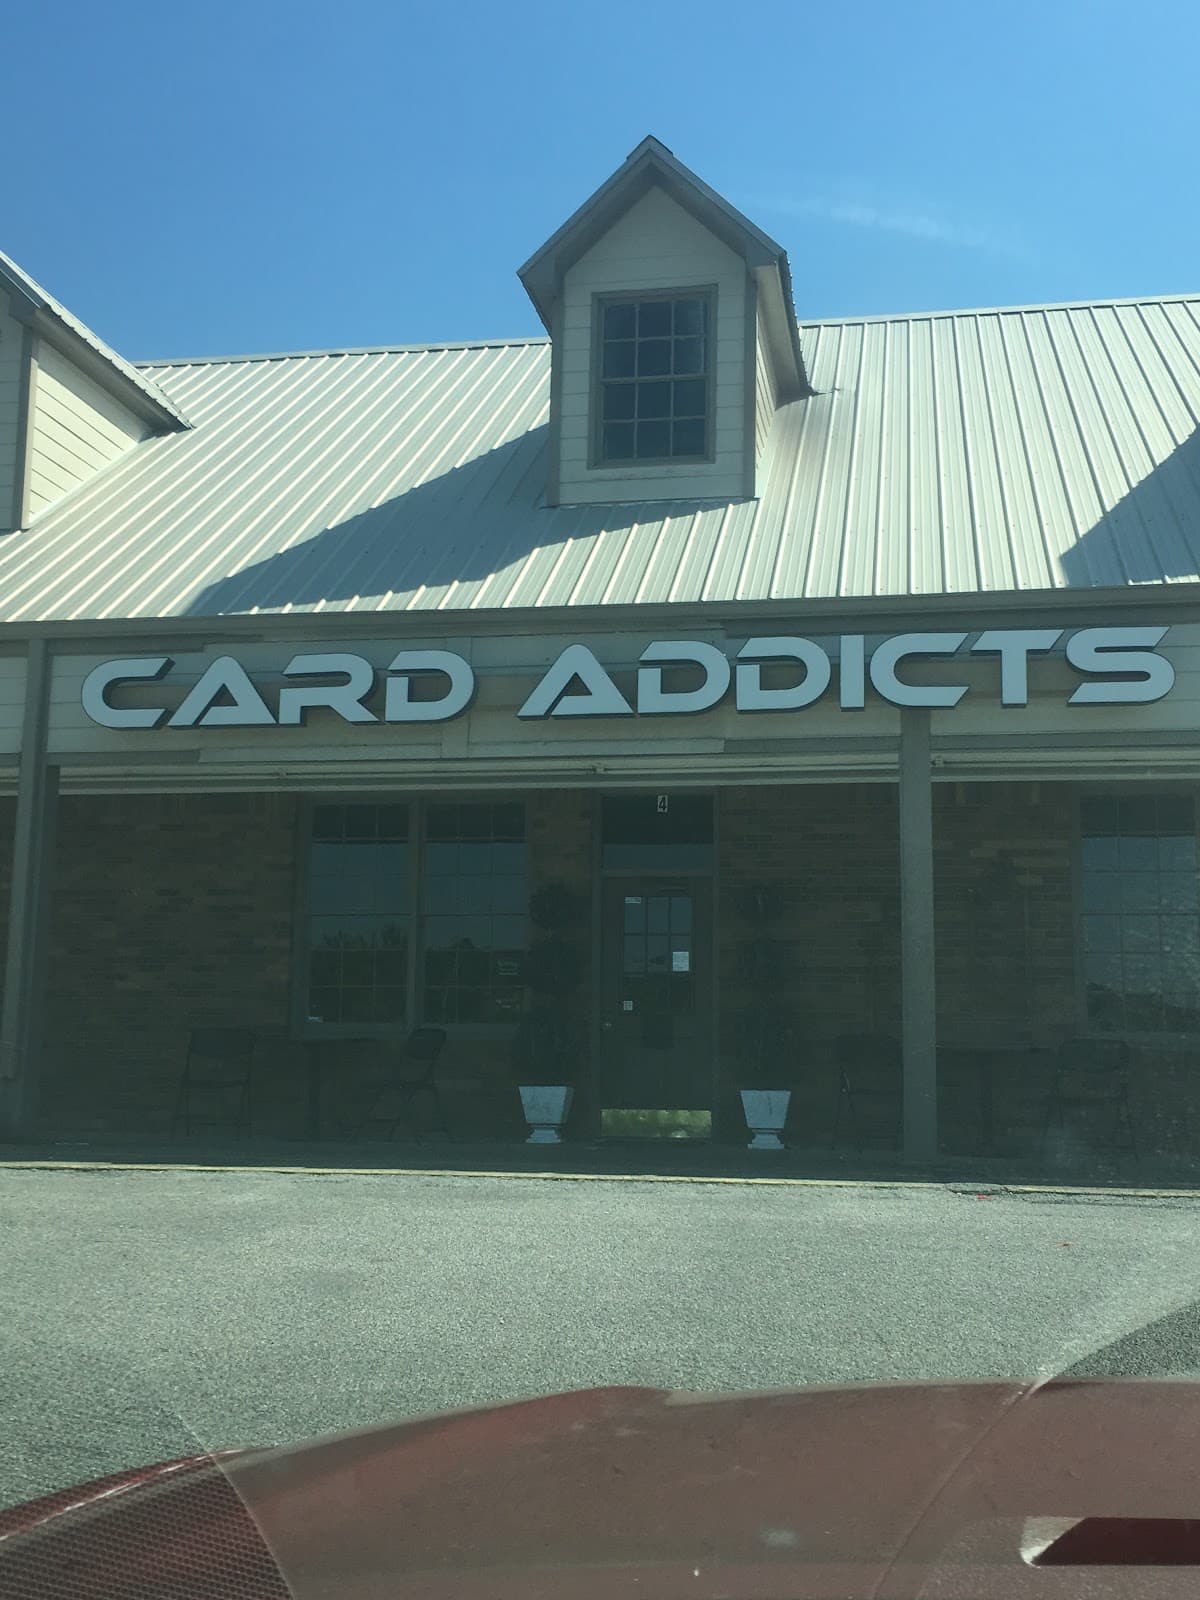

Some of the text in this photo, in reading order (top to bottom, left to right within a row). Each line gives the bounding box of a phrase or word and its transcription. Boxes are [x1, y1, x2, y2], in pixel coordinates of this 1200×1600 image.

[81, 626, 1176, 729] CARD ADDICTS
[658, 796, 668, 811] 4
